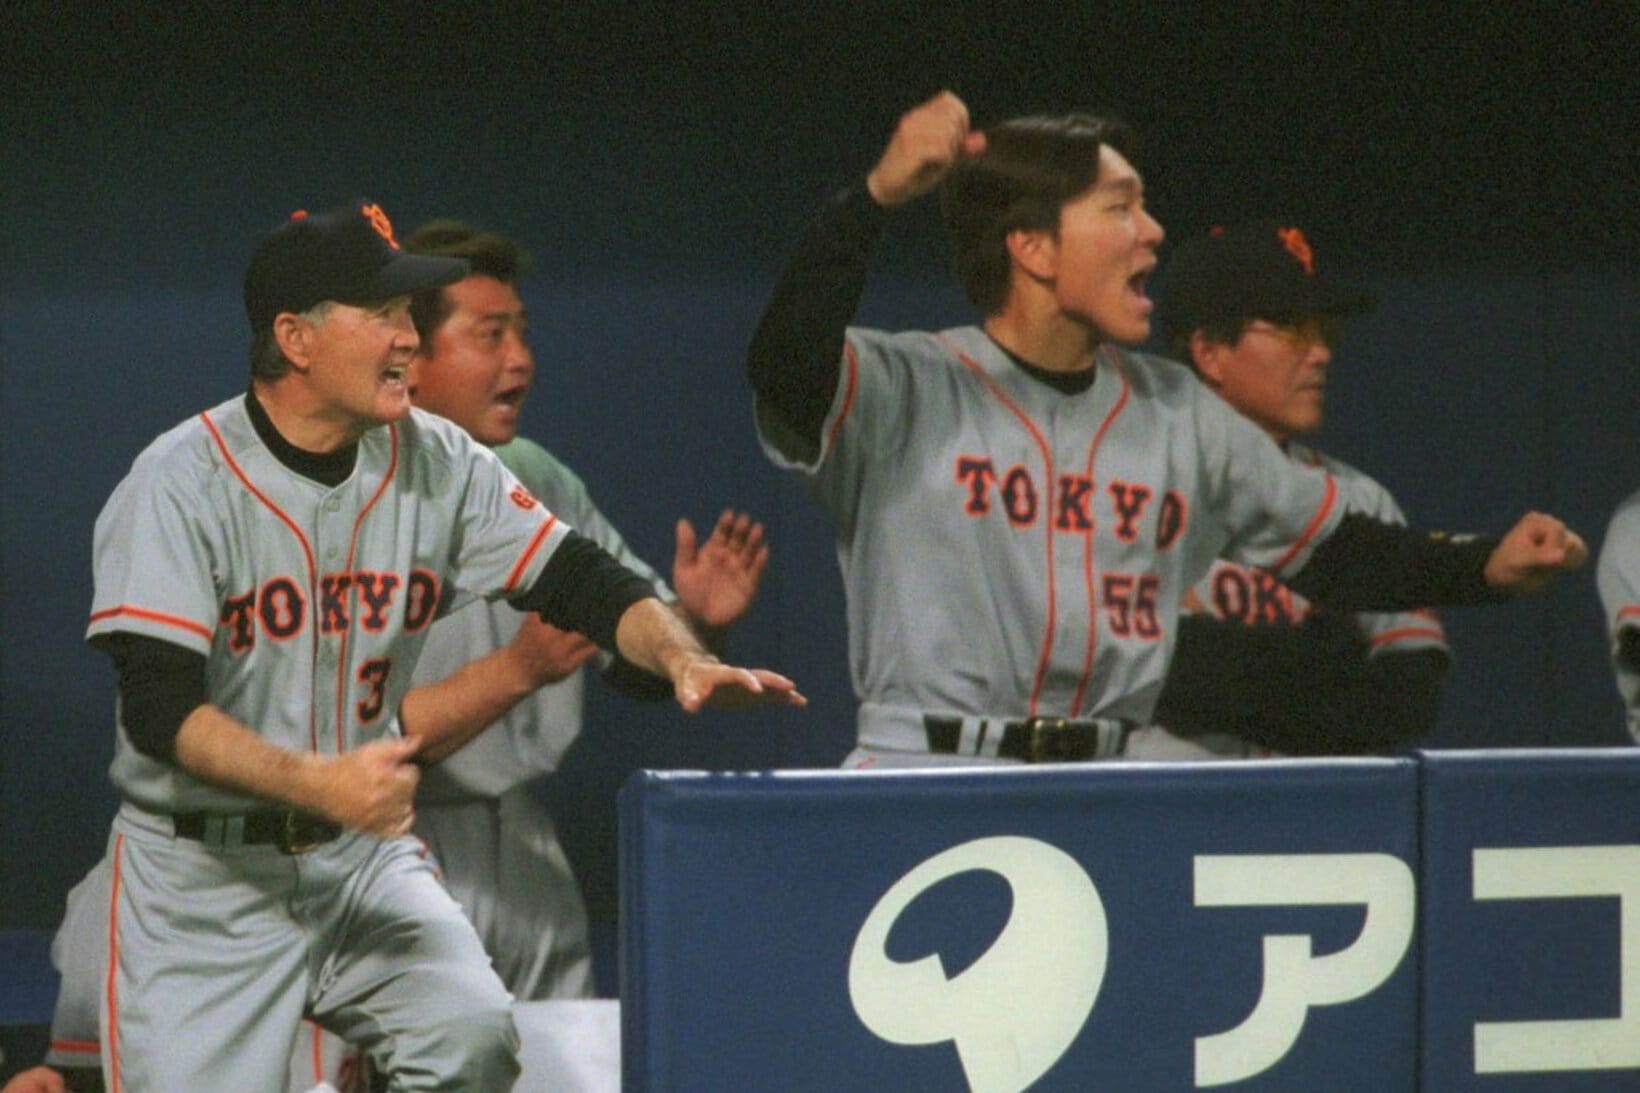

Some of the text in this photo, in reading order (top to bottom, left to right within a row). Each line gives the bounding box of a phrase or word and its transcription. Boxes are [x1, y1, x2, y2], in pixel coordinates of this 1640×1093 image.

[955, 455, 1188, 551] TOKYO
[220, 568, 438, 653] TOKYO
[1101, 572, 1164, 641] 55
[356, 656, 392, 725] 3
